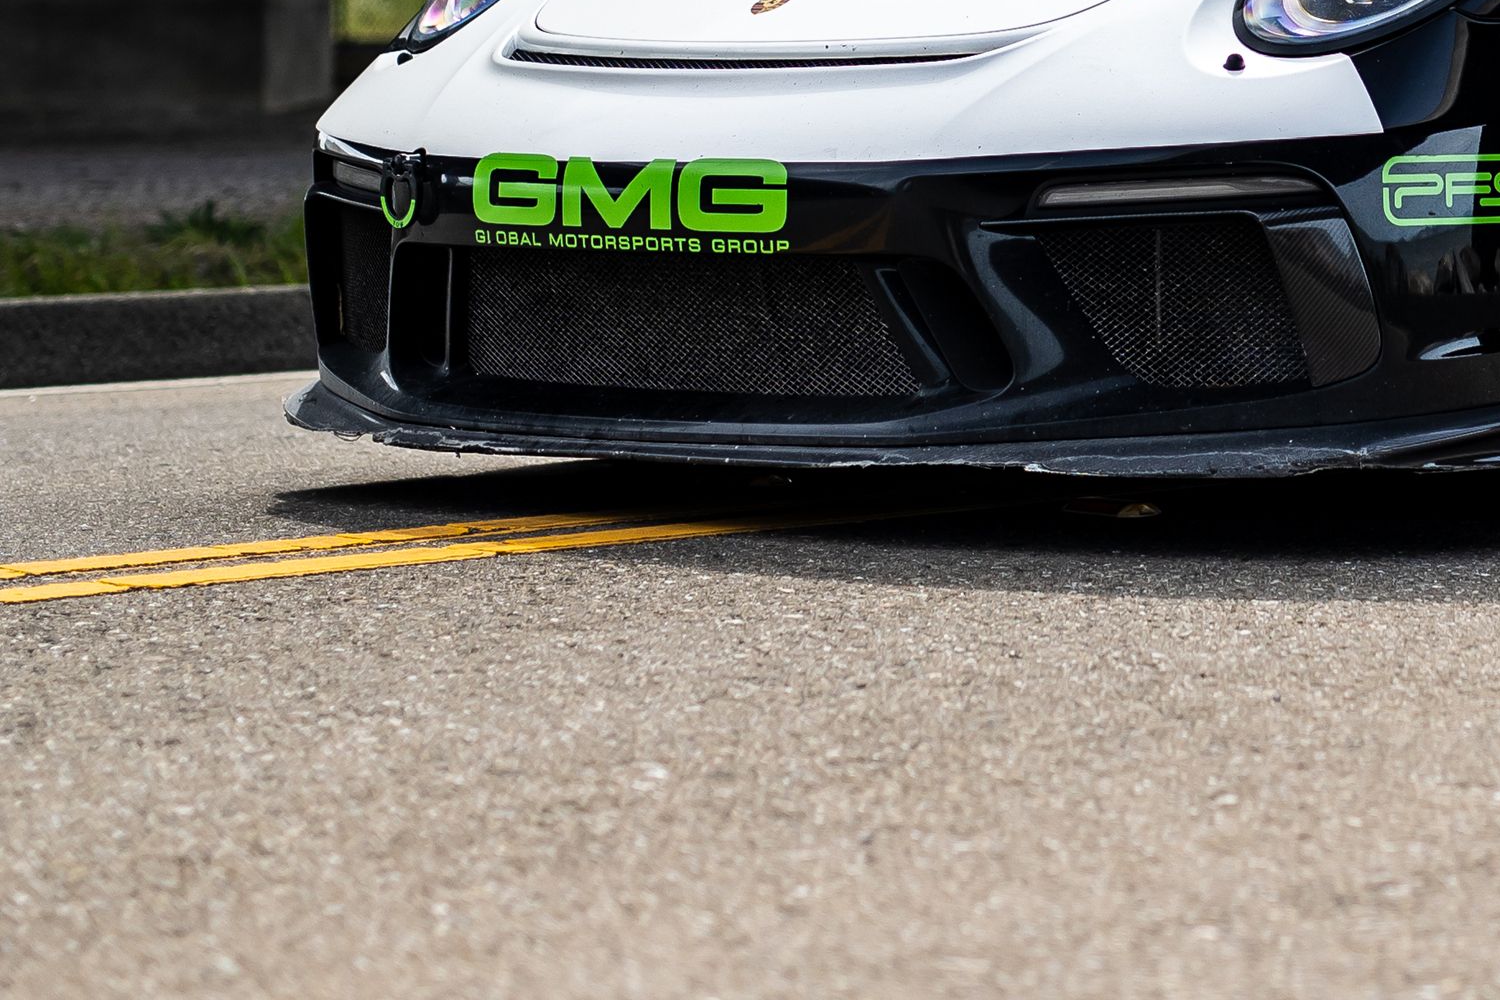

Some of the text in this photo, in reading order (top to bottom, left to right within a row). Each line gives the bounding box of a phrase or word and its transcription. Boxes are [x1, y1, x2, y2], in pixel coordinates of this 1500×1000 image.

[472, 152, 788, 233] GMG
[548, 233, 701, 253] MOTORSPORTS
[711, 238, 790, 254] GROUP
